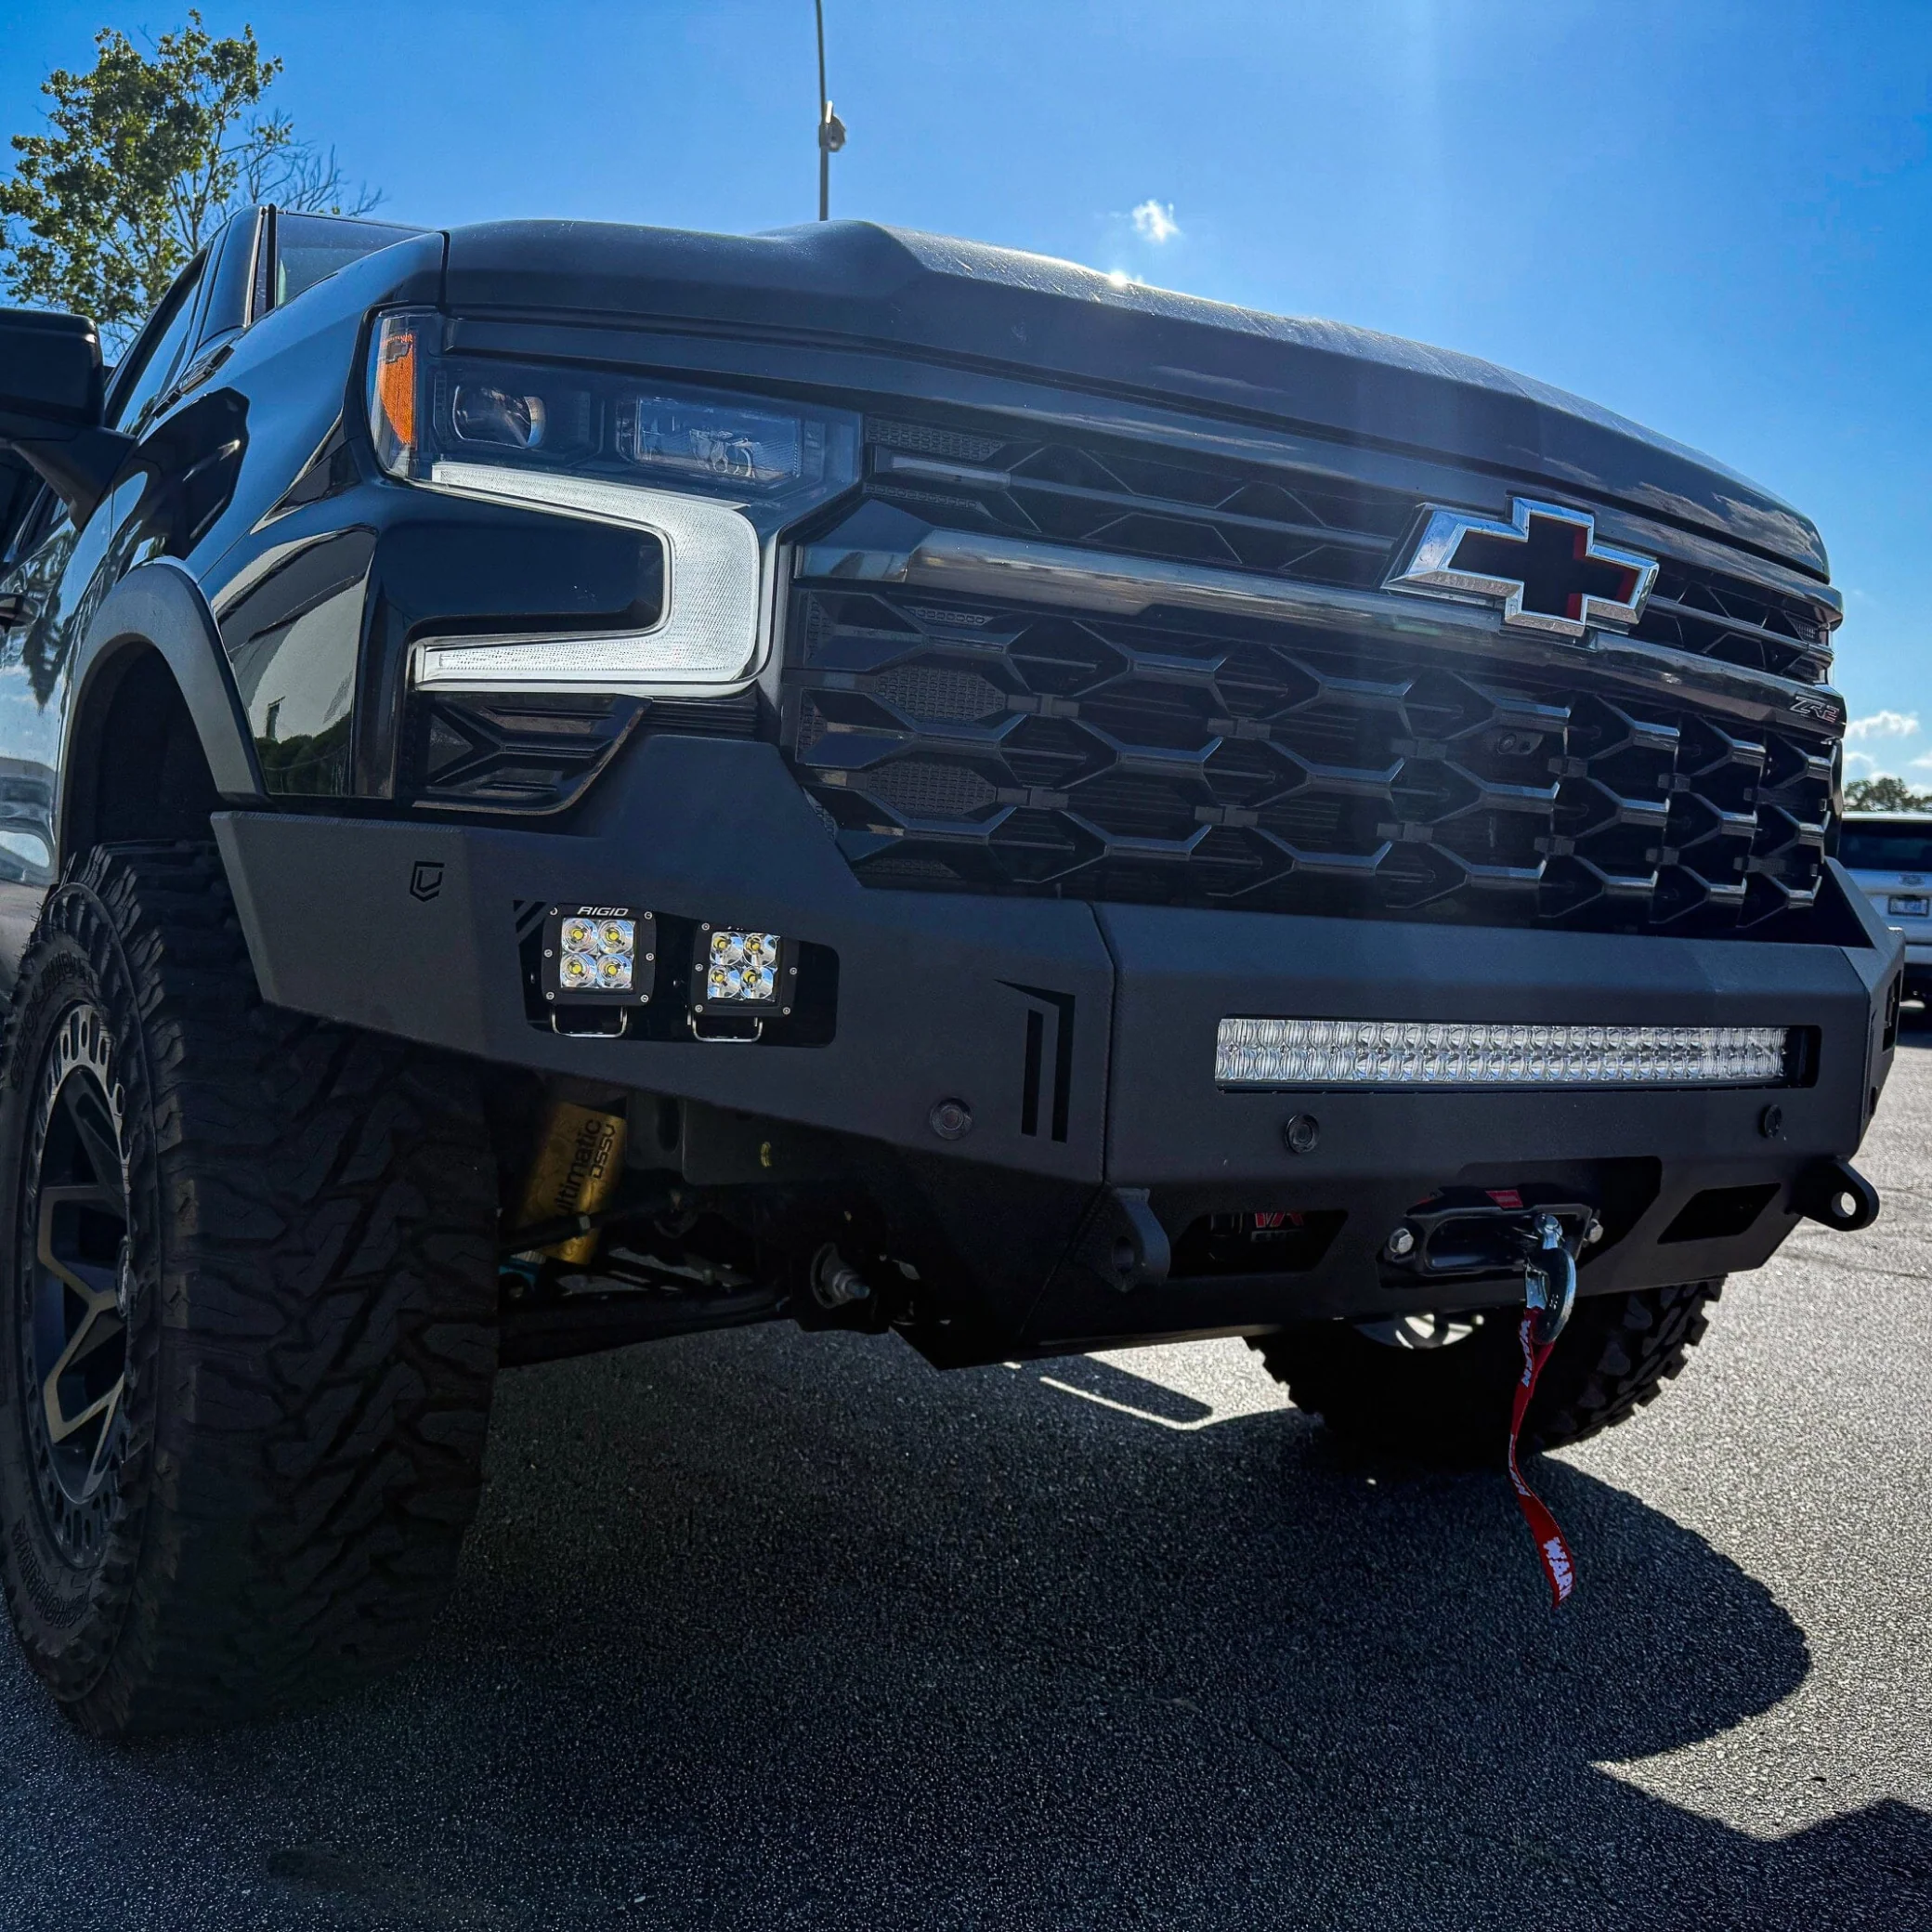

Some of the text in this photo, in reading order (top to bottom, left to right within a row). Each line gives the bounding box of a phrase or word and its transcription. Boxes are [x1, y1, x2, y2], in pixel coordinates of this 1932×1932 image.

[1789, 695, 1840, 724] ZR2
[577, 906, 629, 917] RIGID
[555, 1118, 603, 1216] ultimatic
[1543, 1536, 1573, 1602] WARN
